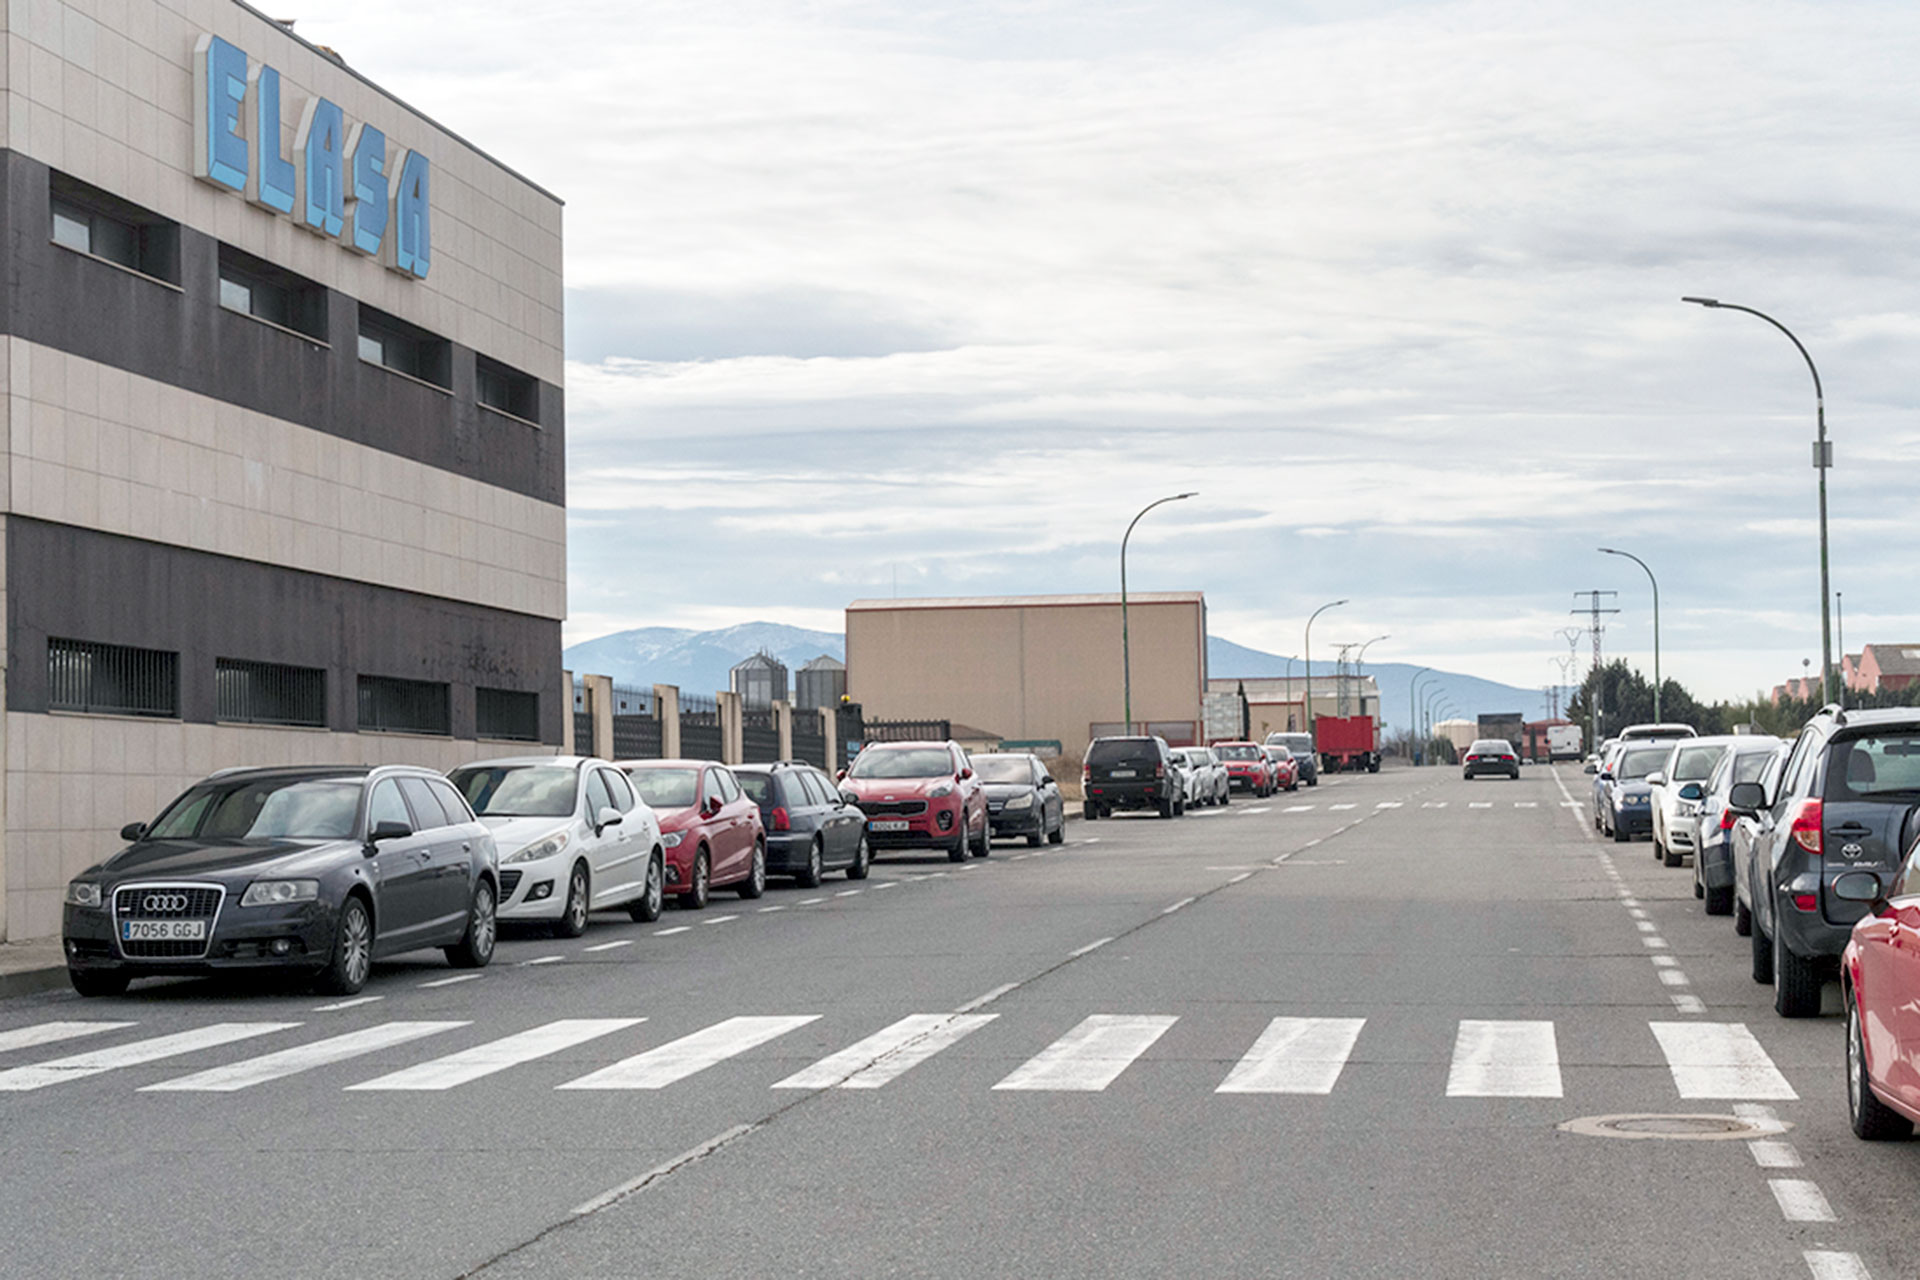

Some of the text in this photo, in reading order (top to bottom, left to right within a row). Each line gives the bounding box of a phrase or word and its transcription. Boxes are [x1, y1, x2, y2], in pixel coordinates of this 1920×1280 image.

[198, 34, 431, 280] ELASA
[132, 923, 202, 938] 7056 GGJ
